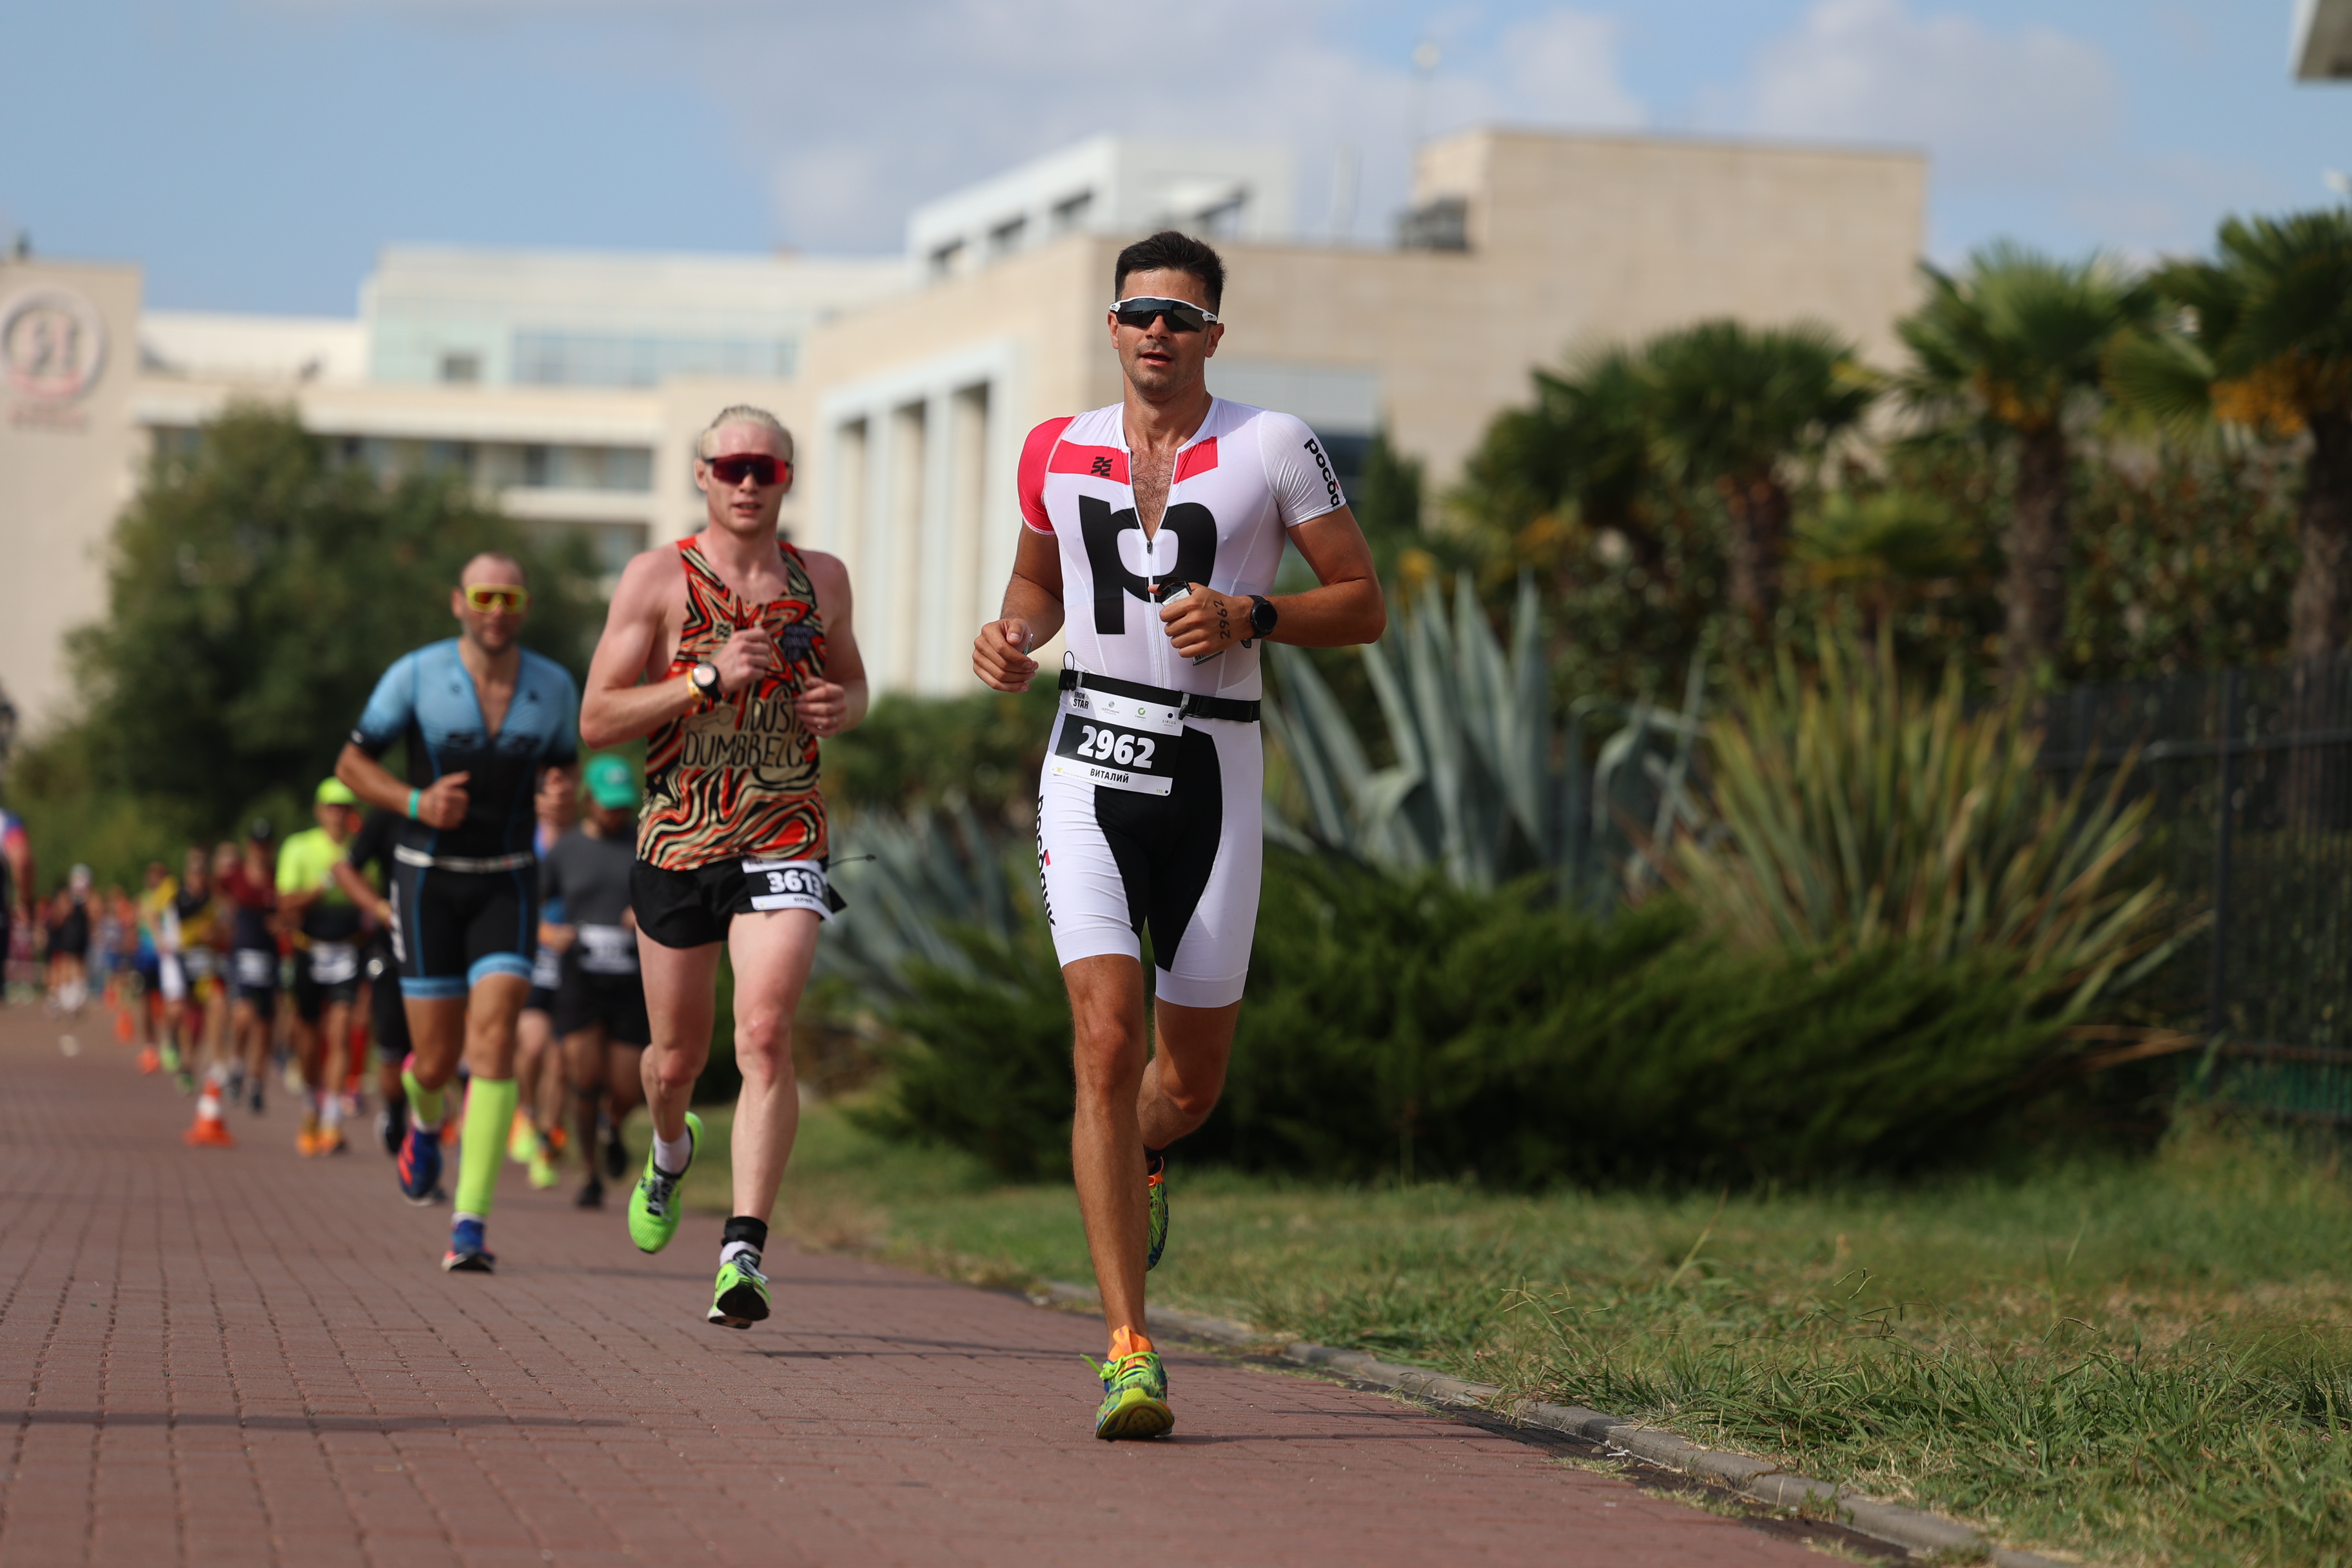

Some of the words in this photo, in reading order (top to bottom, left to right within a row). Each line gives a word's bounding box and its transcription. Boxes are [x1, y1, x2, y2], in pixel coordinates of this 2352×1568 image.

[1213, 600, 1230, 640] 2962
[1073, 698, 1089, 709] STAR
[1077, 725, 1155, 769] 2962
[1090, 768, 1130, 783] ВИТАЛИЙ
